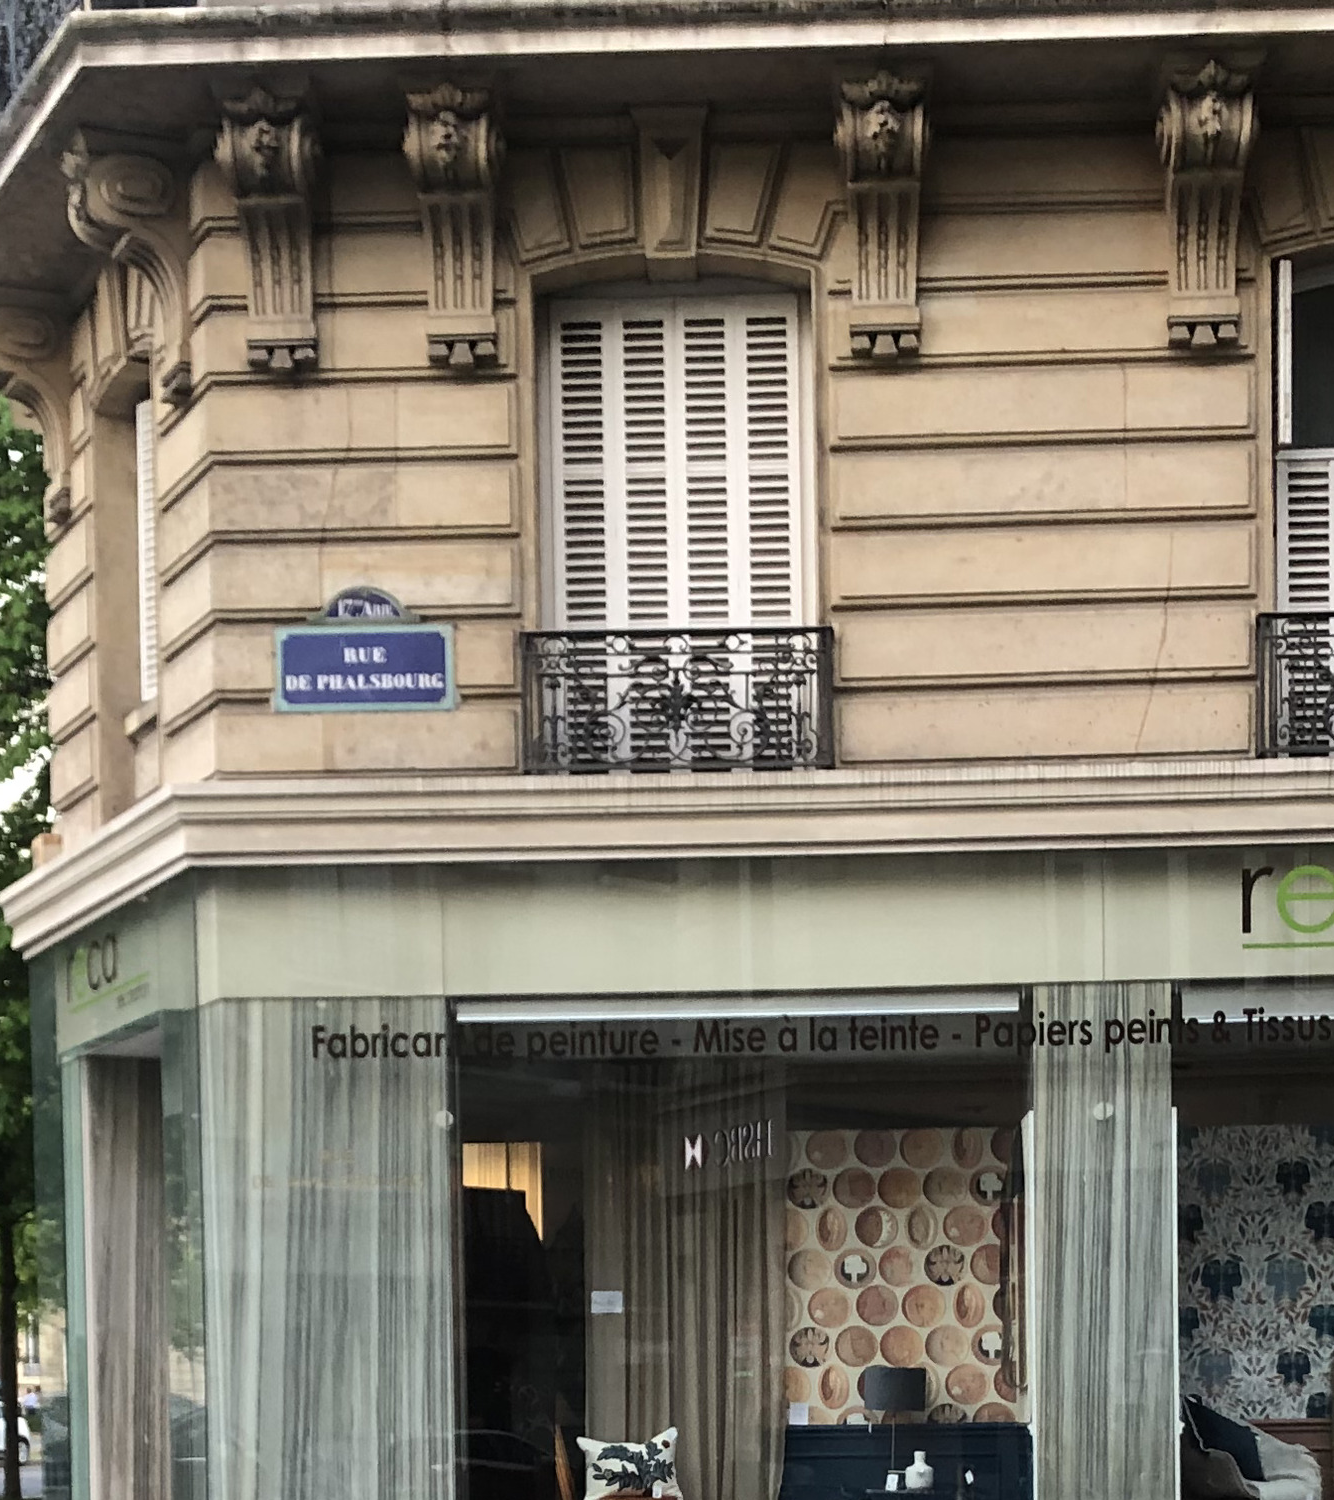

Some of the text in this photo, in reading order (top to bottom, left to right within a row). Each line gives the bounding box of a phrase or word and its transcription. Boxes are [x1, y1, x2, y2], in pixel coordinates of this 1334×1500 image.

[343, 646, 388, 664] RUE
[285, 672, 445, 691] DE PHALSBOURG
[472, 1022, 515, 1057] de
[527, 1021, 659, 1062] peinture
[693, 1018, 767, 1054] Mise
[777, 1015, 798, 1053] à
[809, 1017, 838, 1052] la
[848, 1016, 940, 1052] teinte
[974, 1011, 1093, 1050] Papiers
[1211, 1009, 1233, 1044] &
[1242, 1006, 1332, 1044] Tissus
